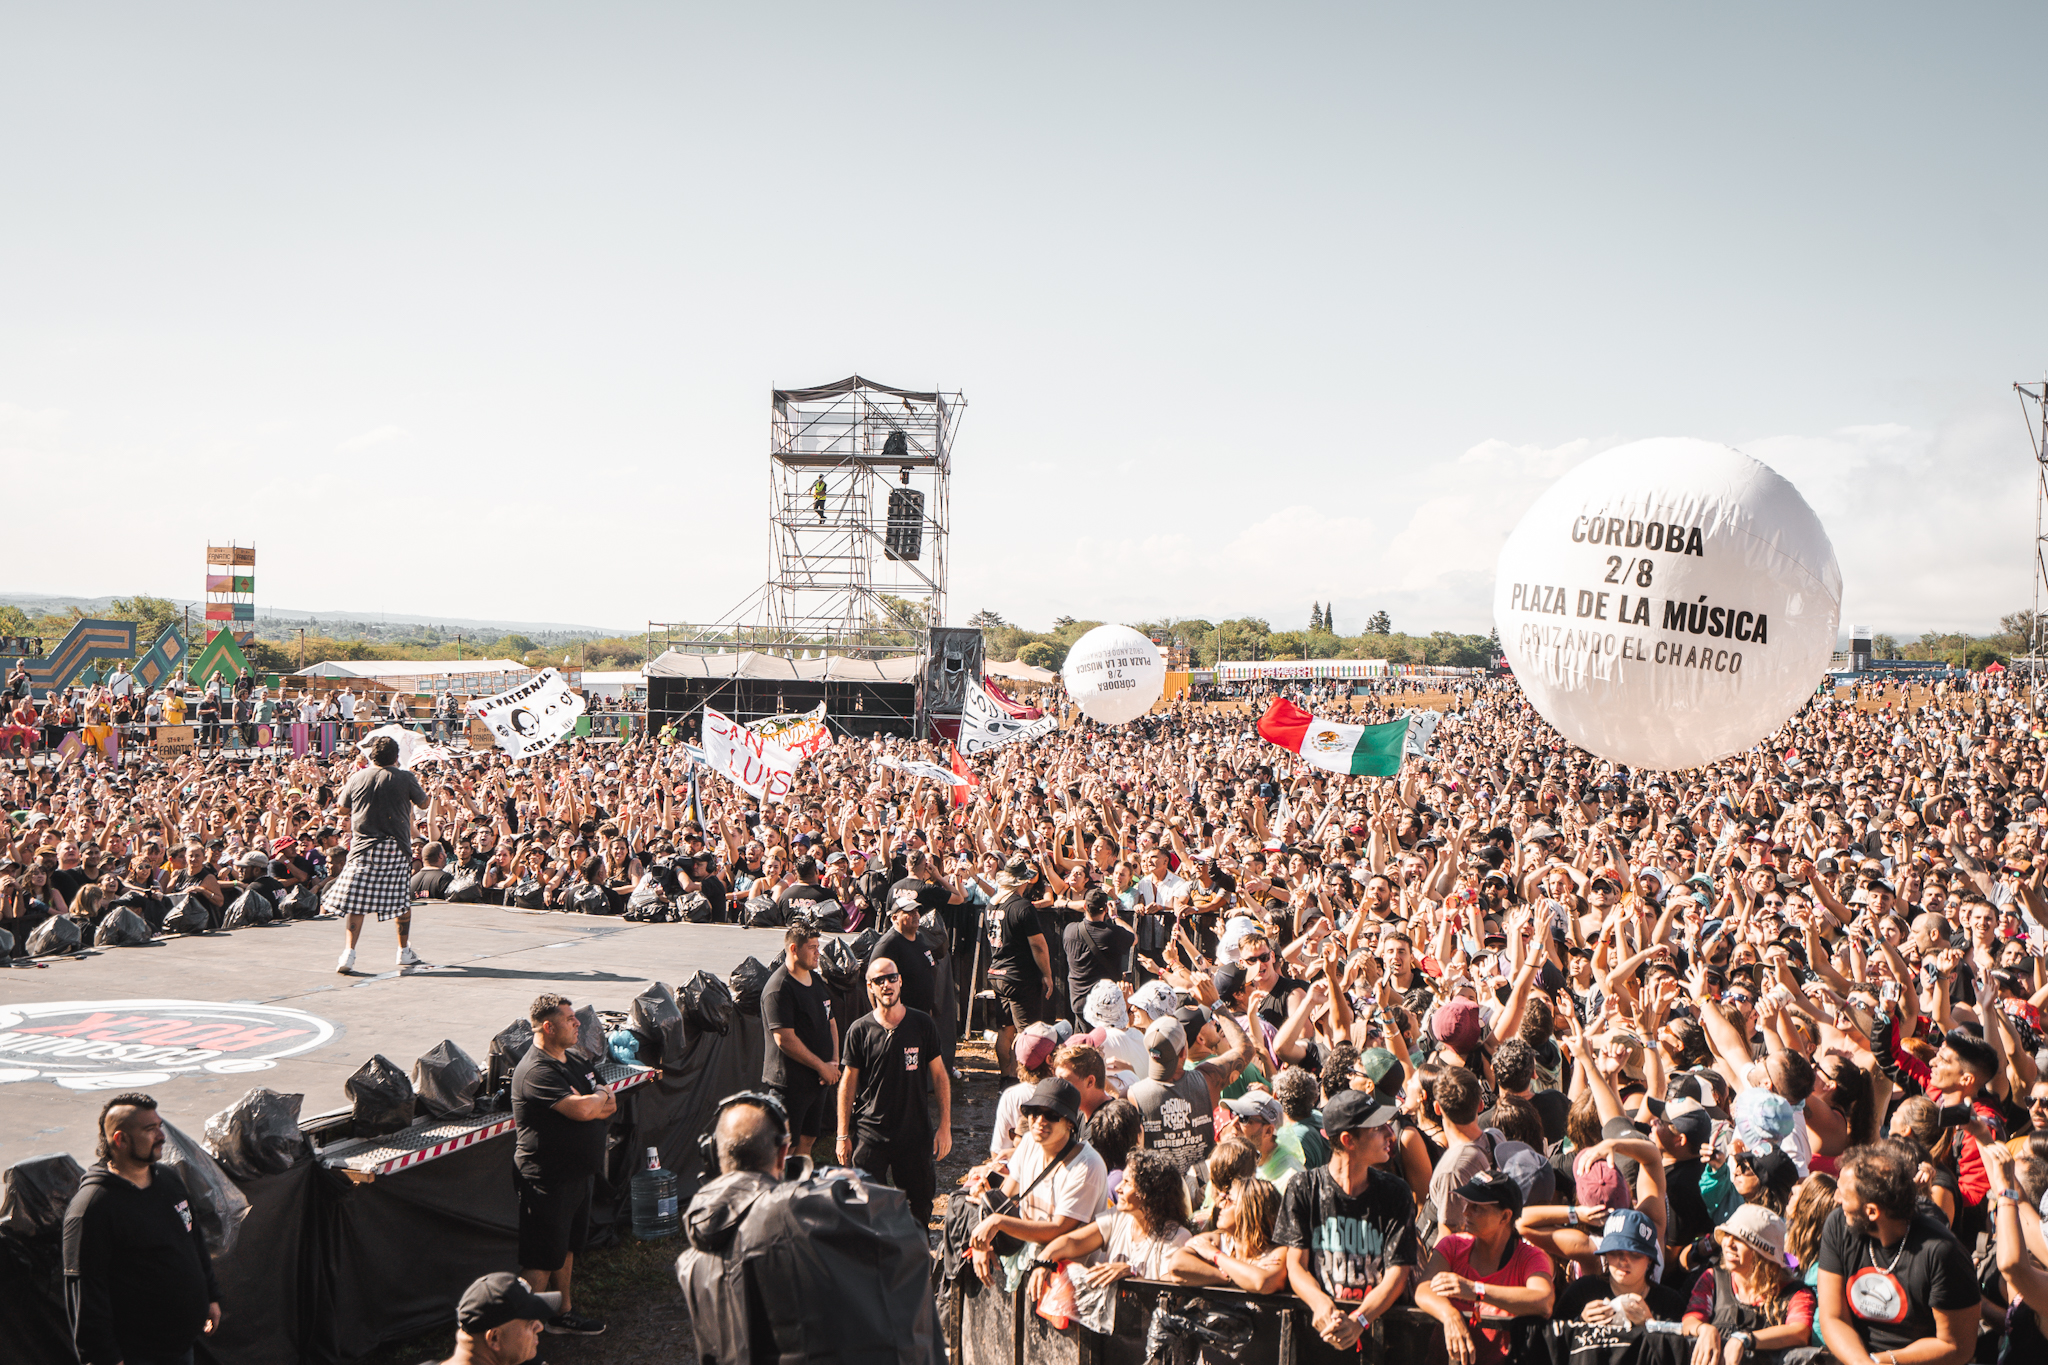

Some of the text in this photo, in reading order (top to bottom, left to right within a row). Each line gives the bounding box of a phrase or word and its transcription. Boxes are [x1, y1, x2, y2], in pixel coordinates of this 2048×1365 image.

[1572, 508, 1704, 557] CÓRDOBA
[236, 554, 255, 562] FANATIC
[1604, 555, 1654, 588] 2/8
[1511, 583, 1768, 645] PLAZA DE LA MÚSICA
[1521, 623, 1743, 674] CRUZANDO EL CHARCO
[1105, 659, 1116, 668] LA
[1117, 658, 1128, 667] DE
[1129, 656, 1151, 667] PLAZA
[1107, 669, 1122, 679] 2/8
[496, 672, 552, 707] PATERNAL
[1097, 679, 1136, 691] CÓRDOBA
[472, 733, 495, 743] FANATIC
[159, 744, 193, 756] FANATIC
[14, 1011, 311, 1053] ROCK
[1163, 1111, 1191, 1129] ROCK
[1164, 1132, 1177, 1140] 10
[1182, 1130, 1192, 1138] 11
[1153, 1138, 1186, 1148] FEBRERO
[1314, 1250, 1384, 1297] ROCK
